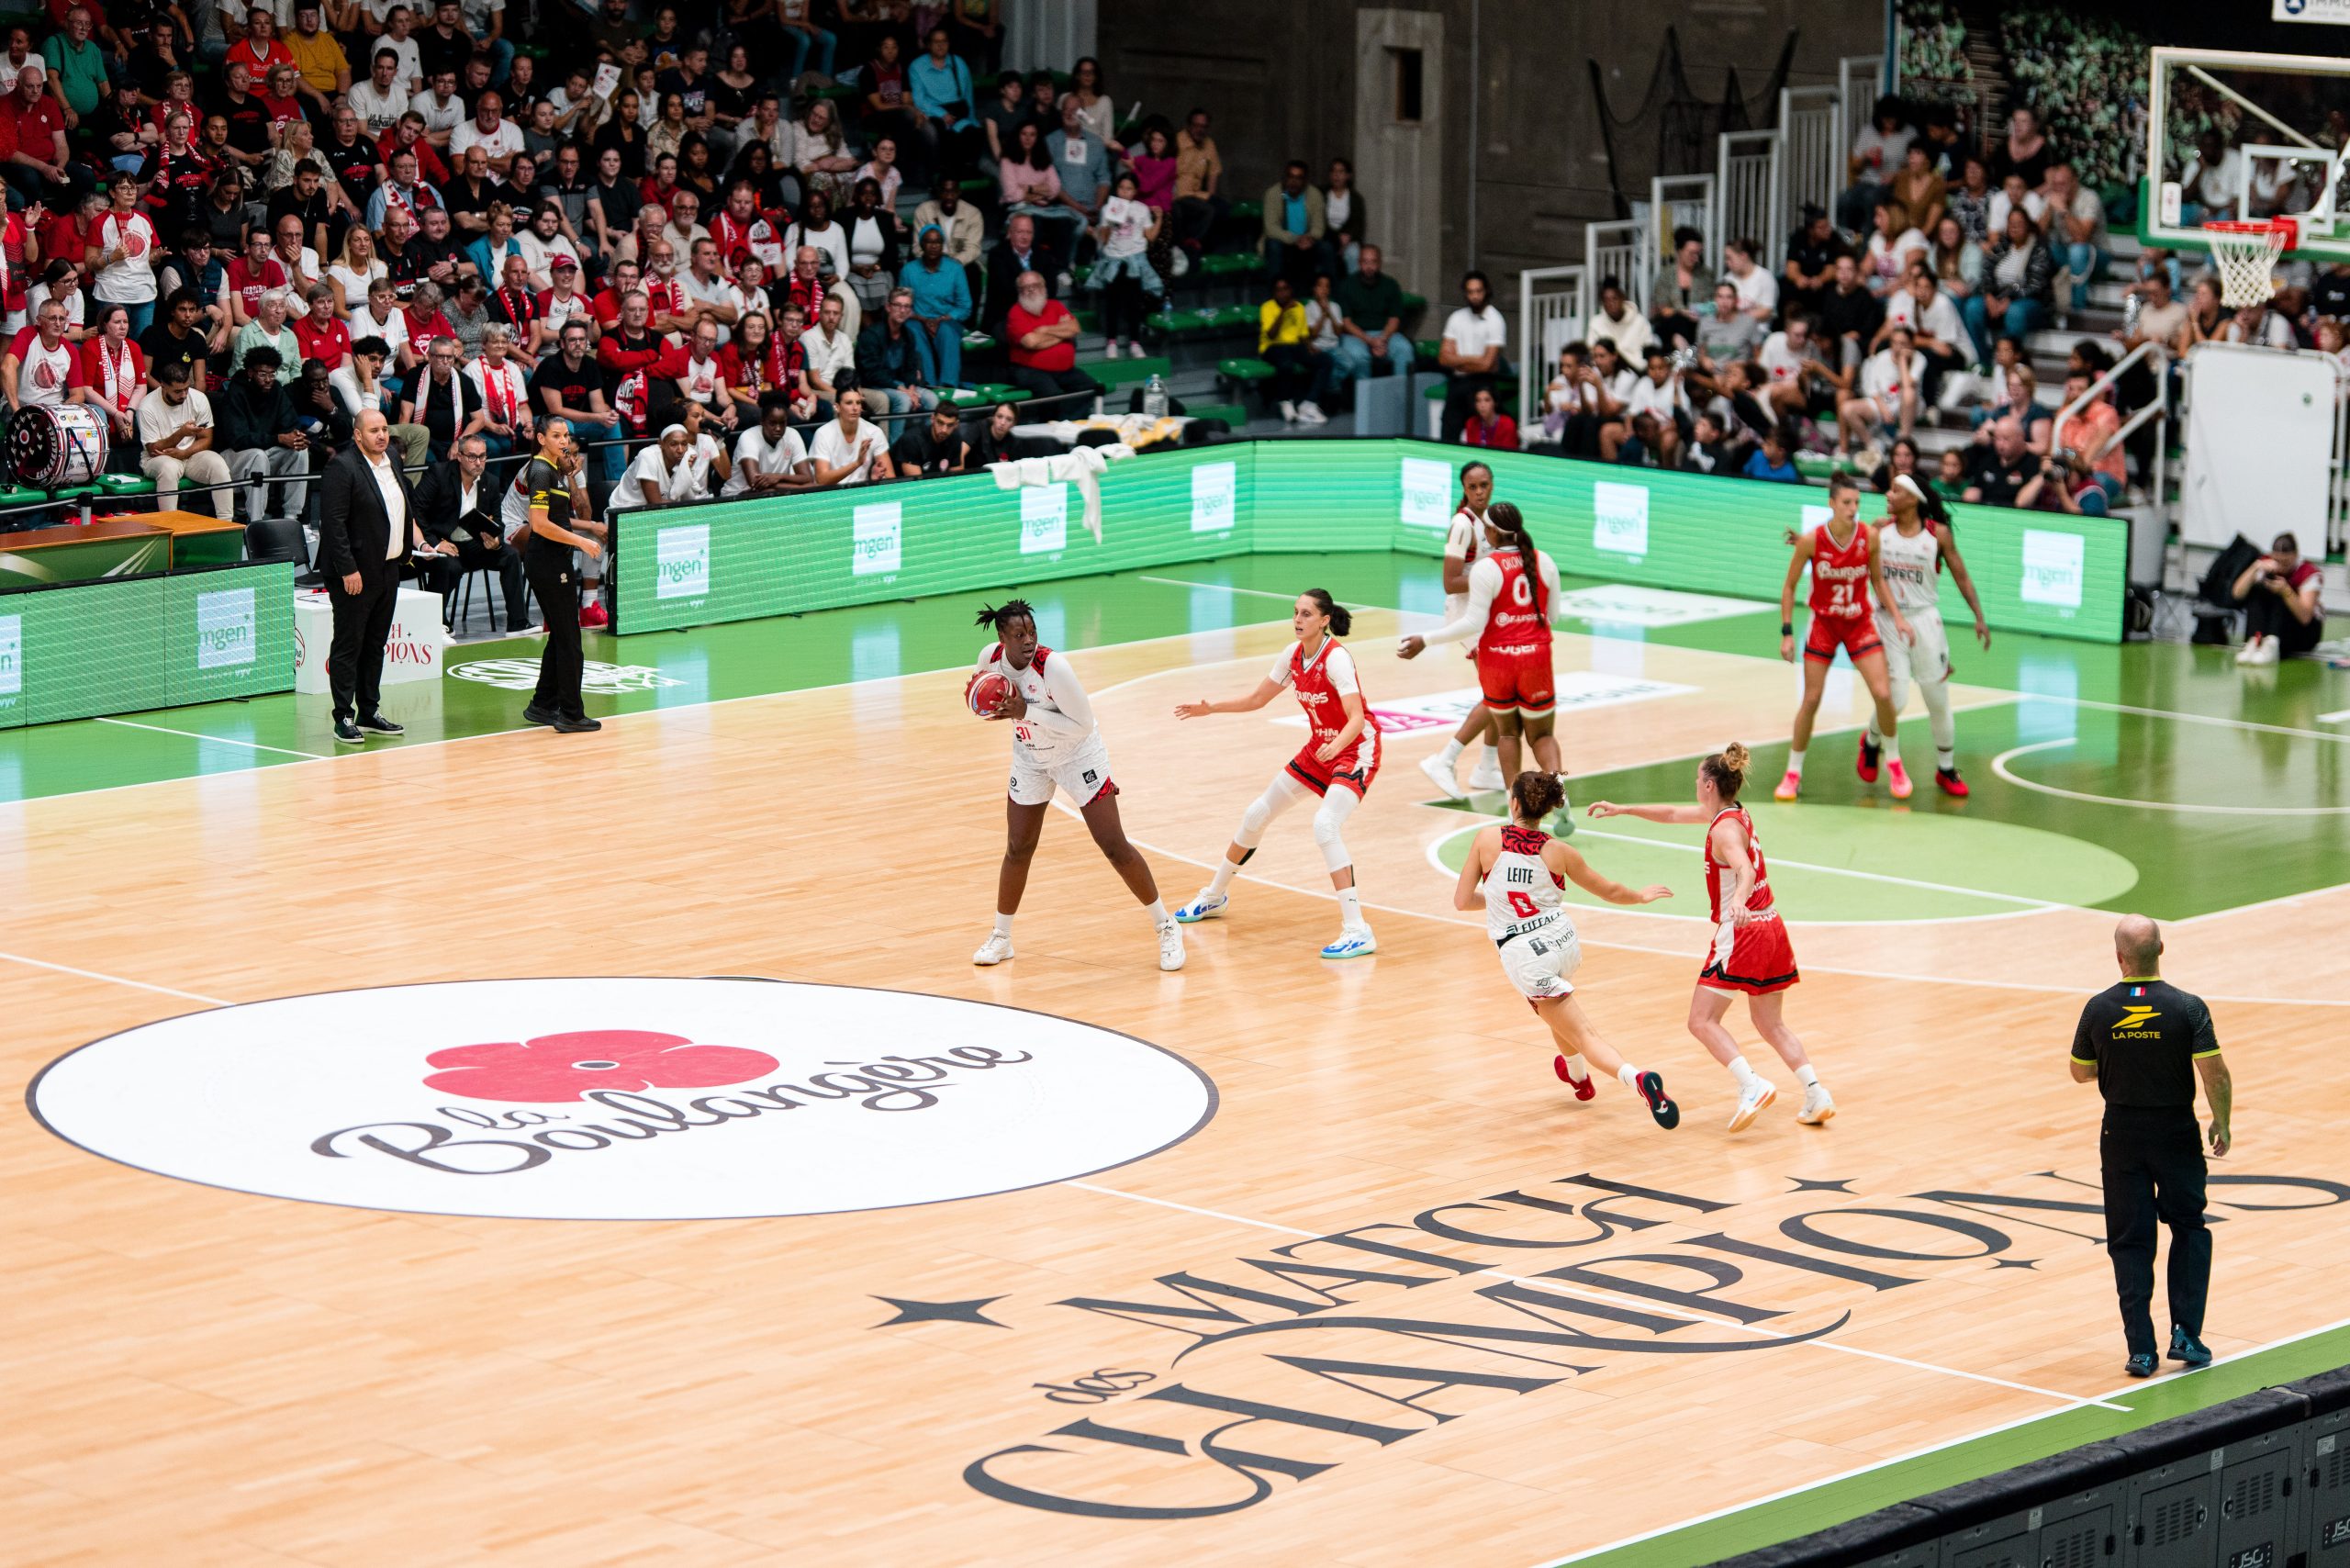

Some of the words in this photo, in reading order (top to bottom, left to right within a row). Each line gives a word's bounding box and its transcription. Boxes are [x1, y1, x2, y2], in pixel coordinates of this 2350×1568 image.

[1023, 515, 1059, 537] mgen
[855, 535, 893, 559] mgen
[658, 558, 701, 583] mgen
[1501, 556, 1524, 570] OKON
[1513, 574, 1532, 606] 0
[1831, 585, 1854, 604] 21
[199, 623, 247, 650] mgen
[1016, 726, 1031, 740] 31
[1507, 867, 1533, 884] LEITE
[1507, 891, 1540, 918] 0
[2128, 1031, 2162, 1039] POSTE
[310, 1046, 1034, 1176] Boulangère
[437, 1107, 570, 1129] la
[1048, 1172, 1739, 1338] MATCH
[1032, 1367, 1158, 1406] des
